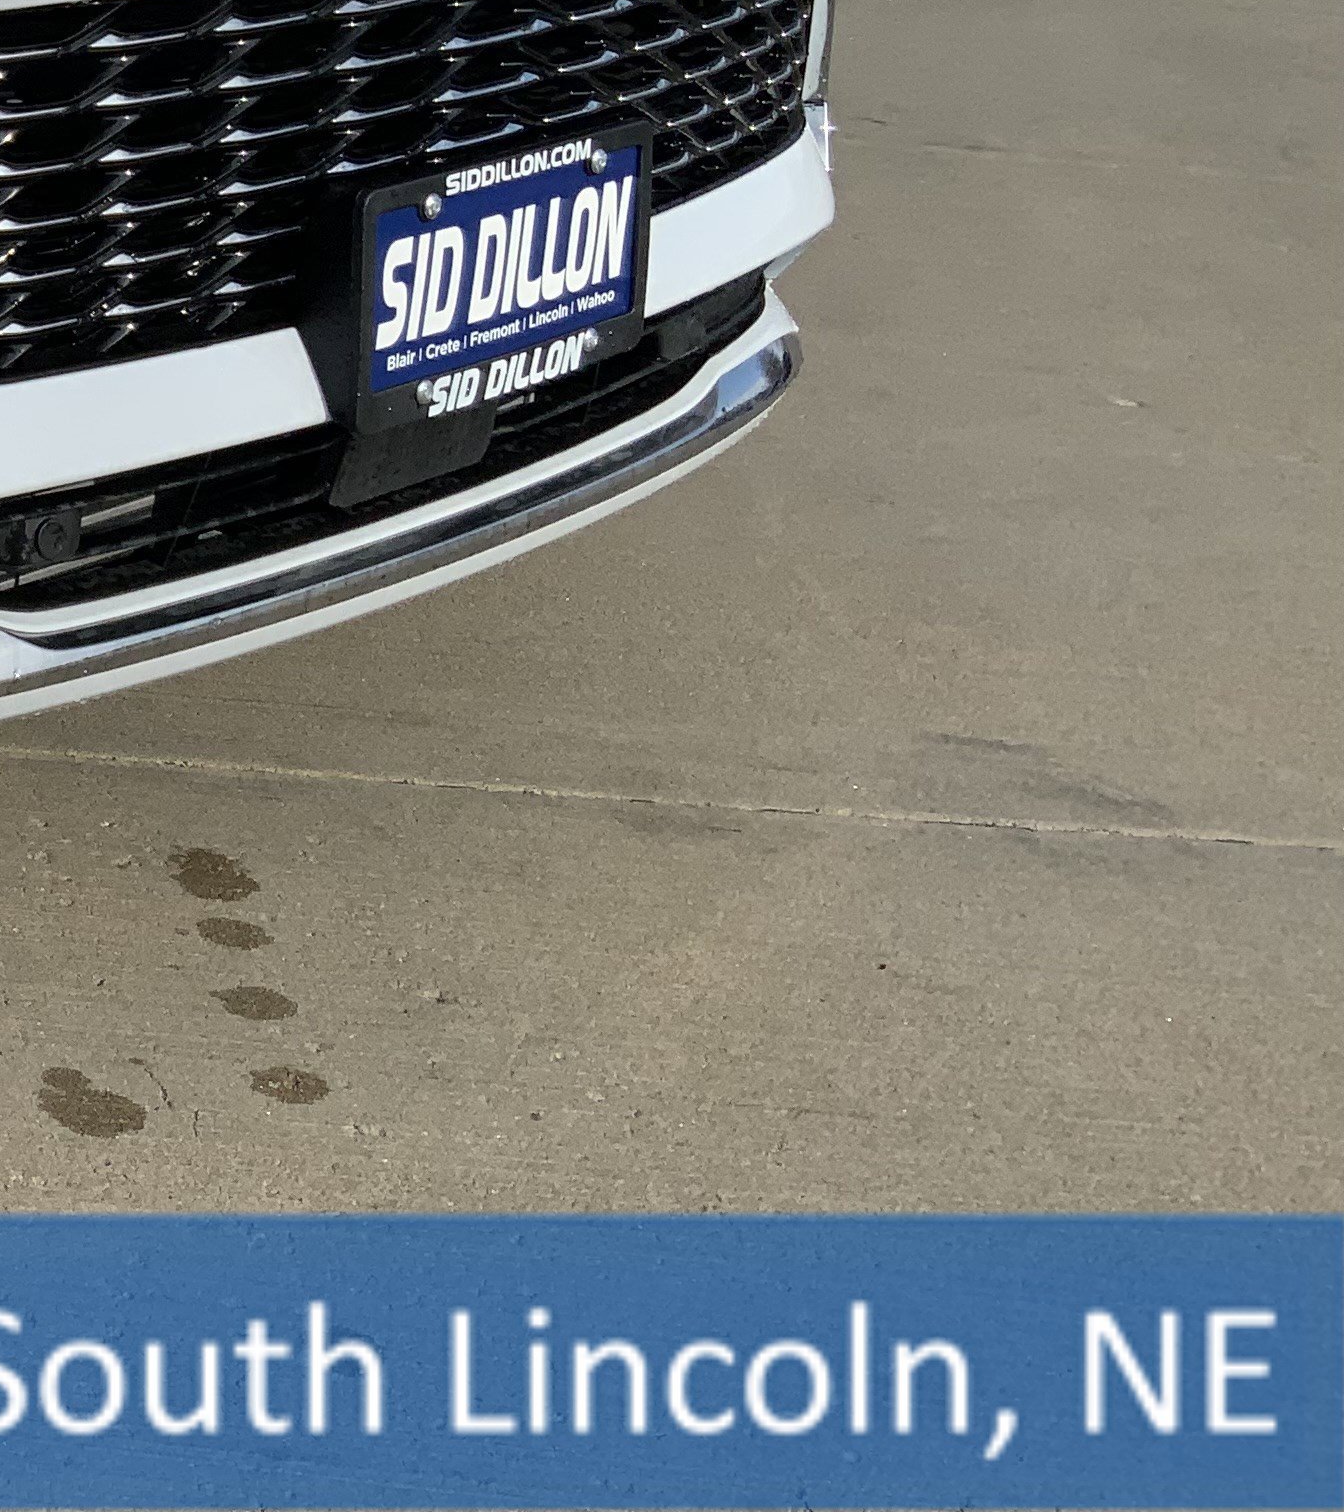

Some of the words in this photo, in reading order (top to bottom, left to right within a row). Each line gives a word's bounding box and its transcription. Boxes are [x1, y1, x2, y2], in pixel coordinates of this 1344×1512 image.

[445, 138, 592, 196] SIDDILLON.COM
[375, 225, 464, 351] SID
[467, 175, 633, 325] DILLON
[386, 350, 416, 372] Blair
[425, 340, 461, 360] Crete
[470, 318, 521, 348] Fremont
[528, 303, 569, 329] Lincoln
[576, 289, 615, 313] Wahoo
[427, 368, 481, 418] SID
[484, 332, 585, 401] DILLON
